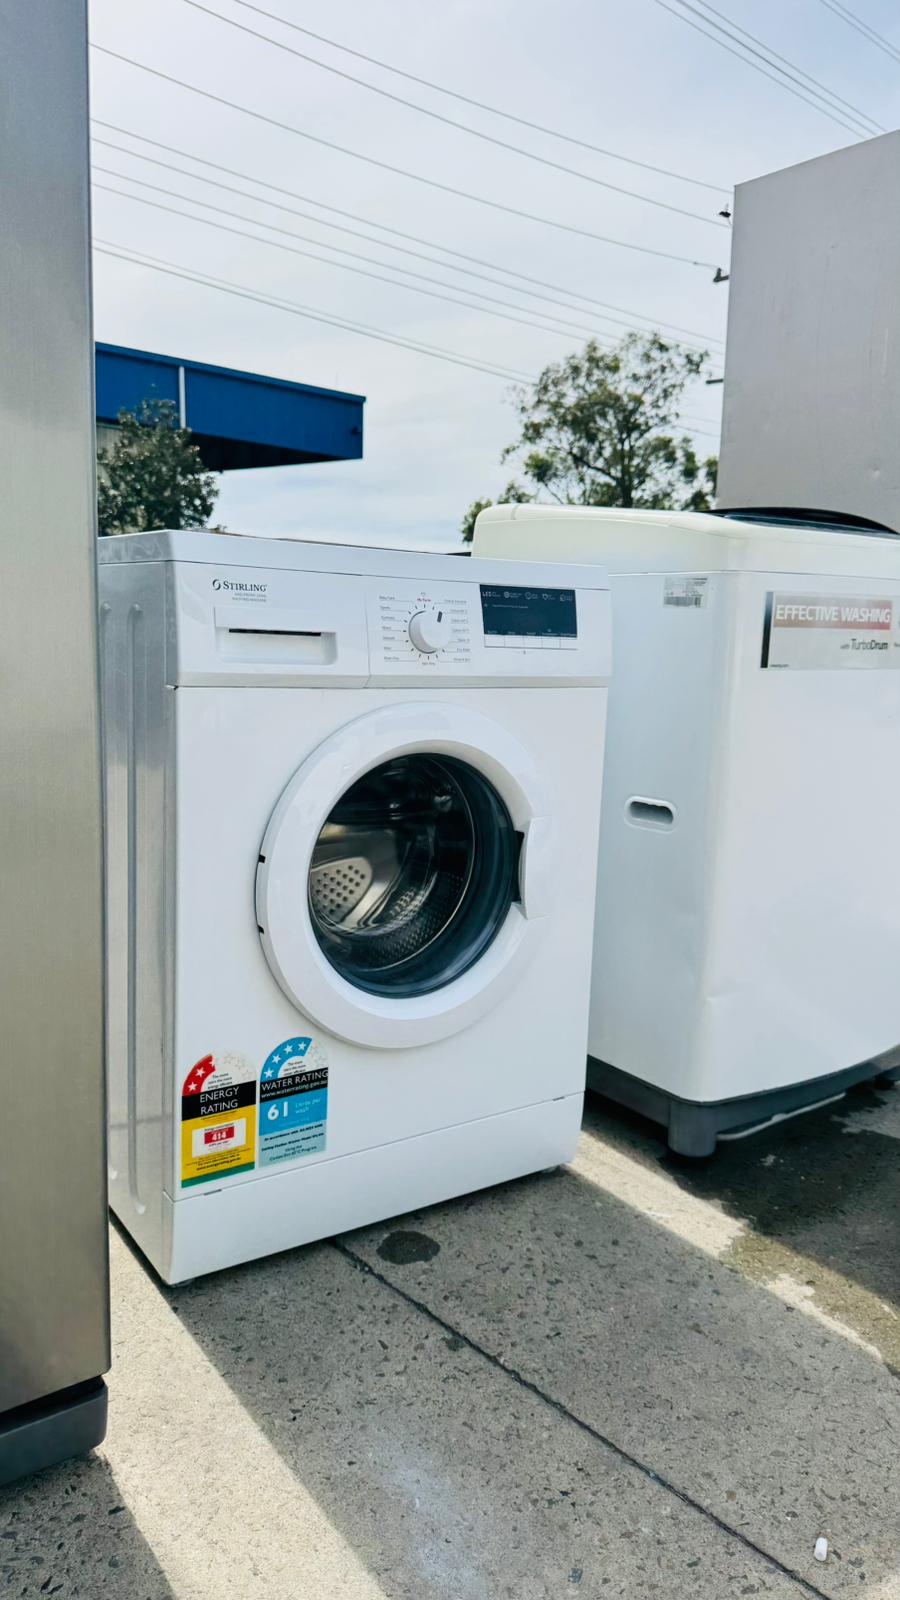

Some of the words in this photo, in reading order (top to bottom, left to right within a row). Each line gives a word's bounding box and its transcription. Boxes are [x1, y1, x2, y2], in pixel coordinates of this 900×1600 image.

[223, 580, 267, 592] STIRLING
[776, 604, 839, 621] EFFECTIVE
[840, 607, 891, 624] WASHING
[850, 638, 889, 650] TurboDrum
[261, 1078, 293, 1091] WATER
[295, 1070, 328, 1084] RATING
[200, 1086, 239, 1103] ENERGY
[200, 1099, 239, 1115] RATING
[267, 1101, 289, 1120] 61
